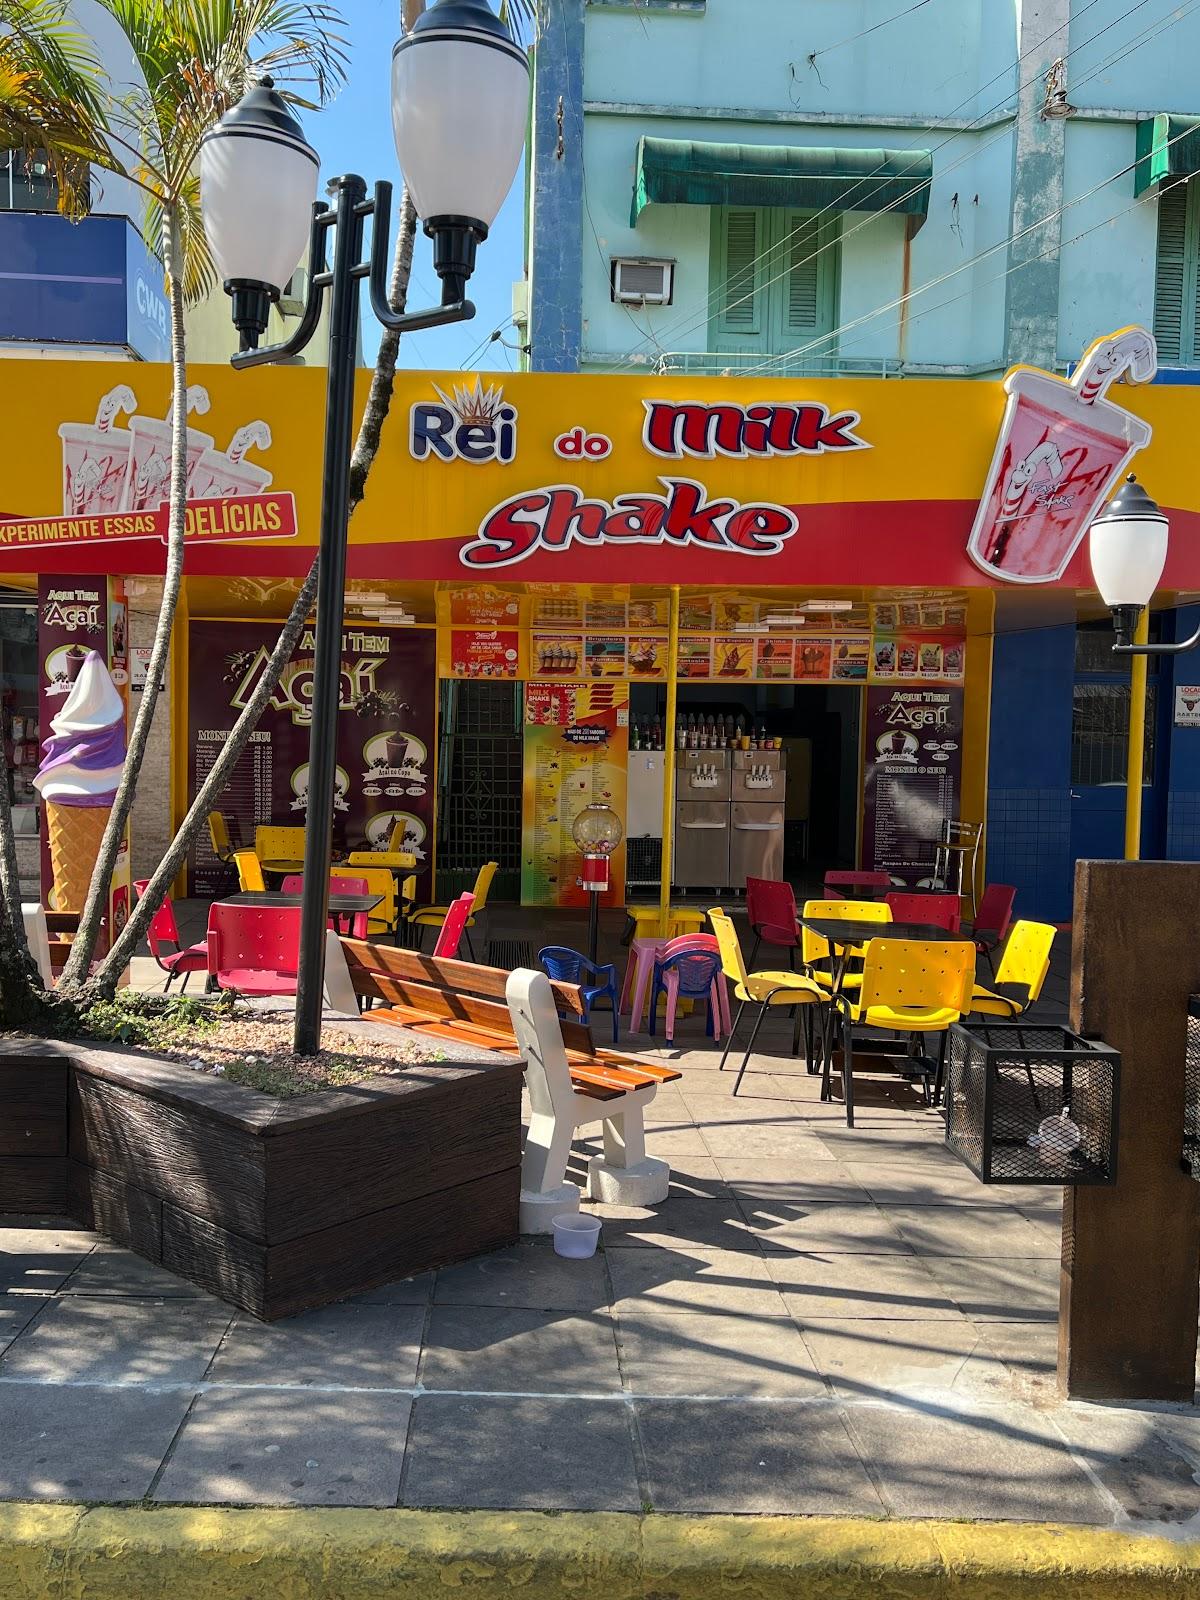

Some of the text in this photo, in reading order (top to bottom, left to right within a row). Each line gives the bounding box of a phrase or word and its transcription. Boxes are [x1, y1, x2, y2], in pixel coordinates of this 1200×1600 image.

[411, 403, 516, 463] Rei
[555, 429, 611, 459] do
[104, 515, 156, 535] ESSAS
[184, 499, 282, 536] DELÍCIAS
[44, 601, 100, 631] Açaí
[349, 632, 390, 653] TEM
[891, 692, 950, 702] AQUI TEM
[886, 702, 951, 729] Açaí
